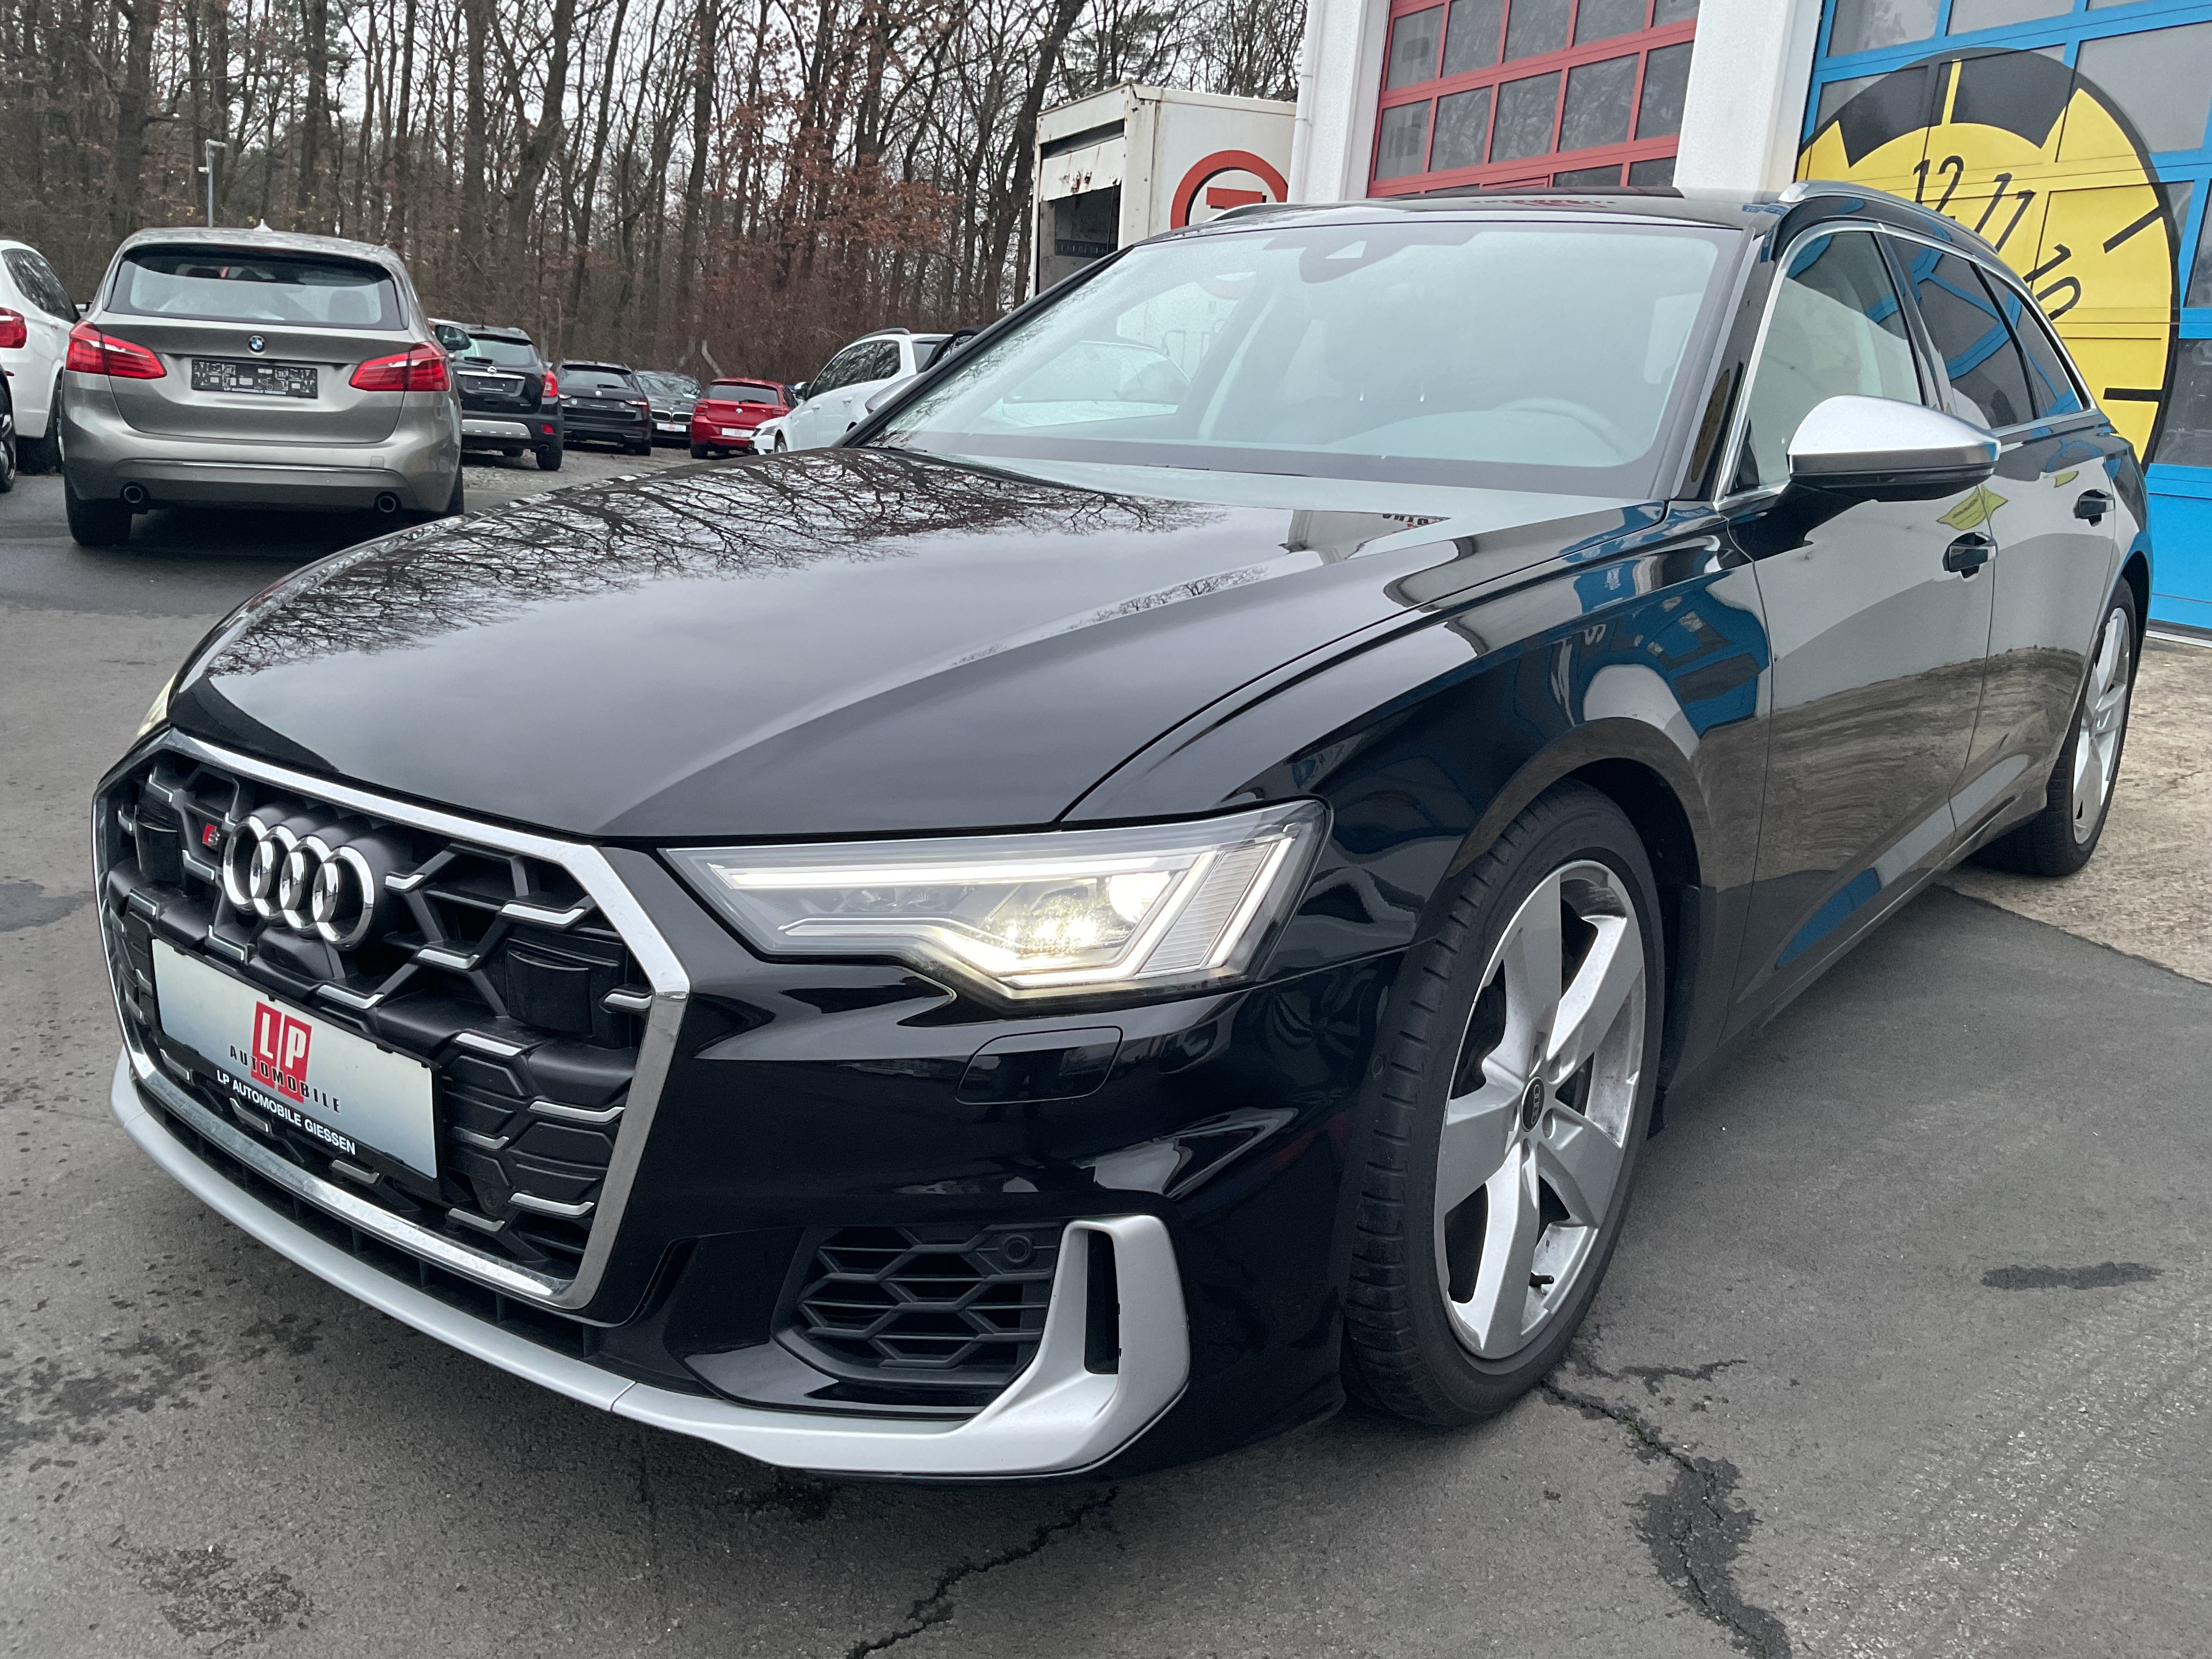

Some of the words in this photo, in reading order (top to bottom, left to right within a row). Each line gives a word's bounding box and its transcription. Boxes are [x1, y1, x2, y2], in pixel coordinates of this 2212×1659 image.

[1913, 155, 1963, 221] 12
[1974, 172, 2036, 255] 11
[2023, 244, 2081, 321] 10
[259, 1012, 307, 1069] LP
[217, 1070, 229, 1085] LP
[233, 1080, 302, 1127] AUTOMOBILE
[304, 1119, 356, 1155] GIESSEN
[230, 1045, 341, 1114] AUTOMOBILE
